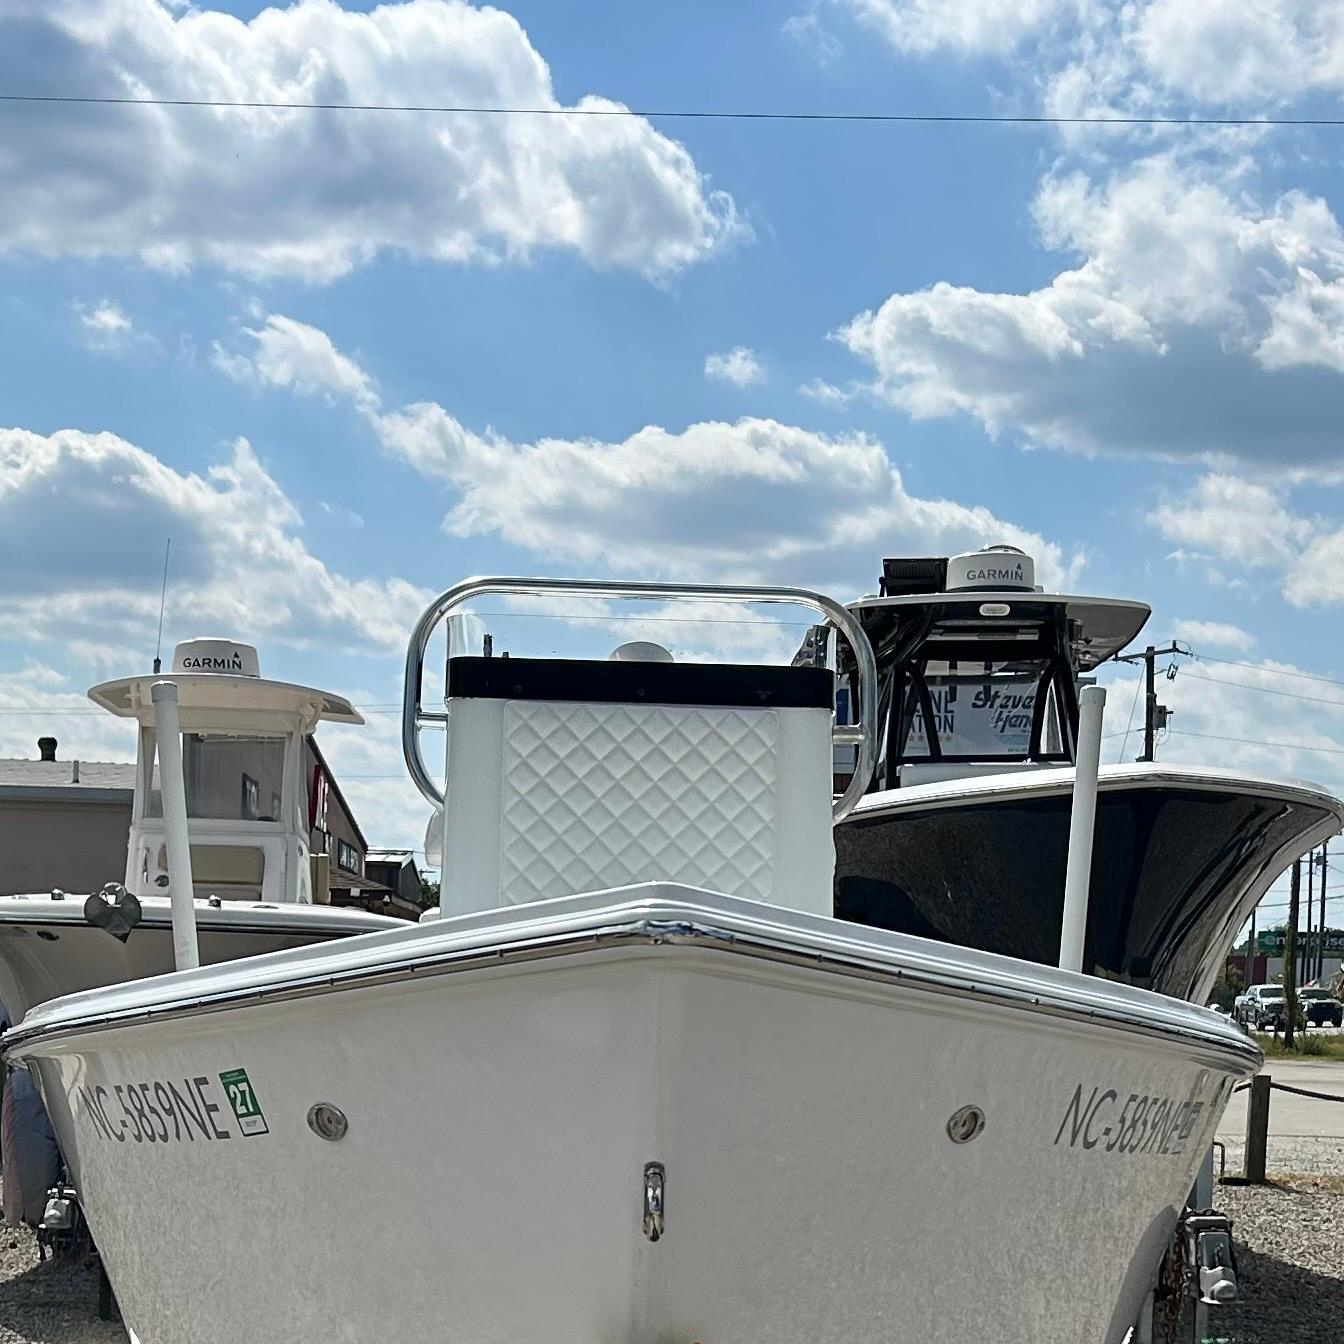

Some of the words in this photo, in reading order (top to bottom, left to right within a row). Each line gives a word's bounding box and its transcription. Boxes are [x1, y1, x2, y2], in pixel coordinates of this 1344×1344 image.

[966, 568, 1024, 581] GARMIN
[182, 657, 242, 671] GARMIN
[78, 1076, 232, 1143] NC-5859NE
[228, 1081, 254, 1115] 27
